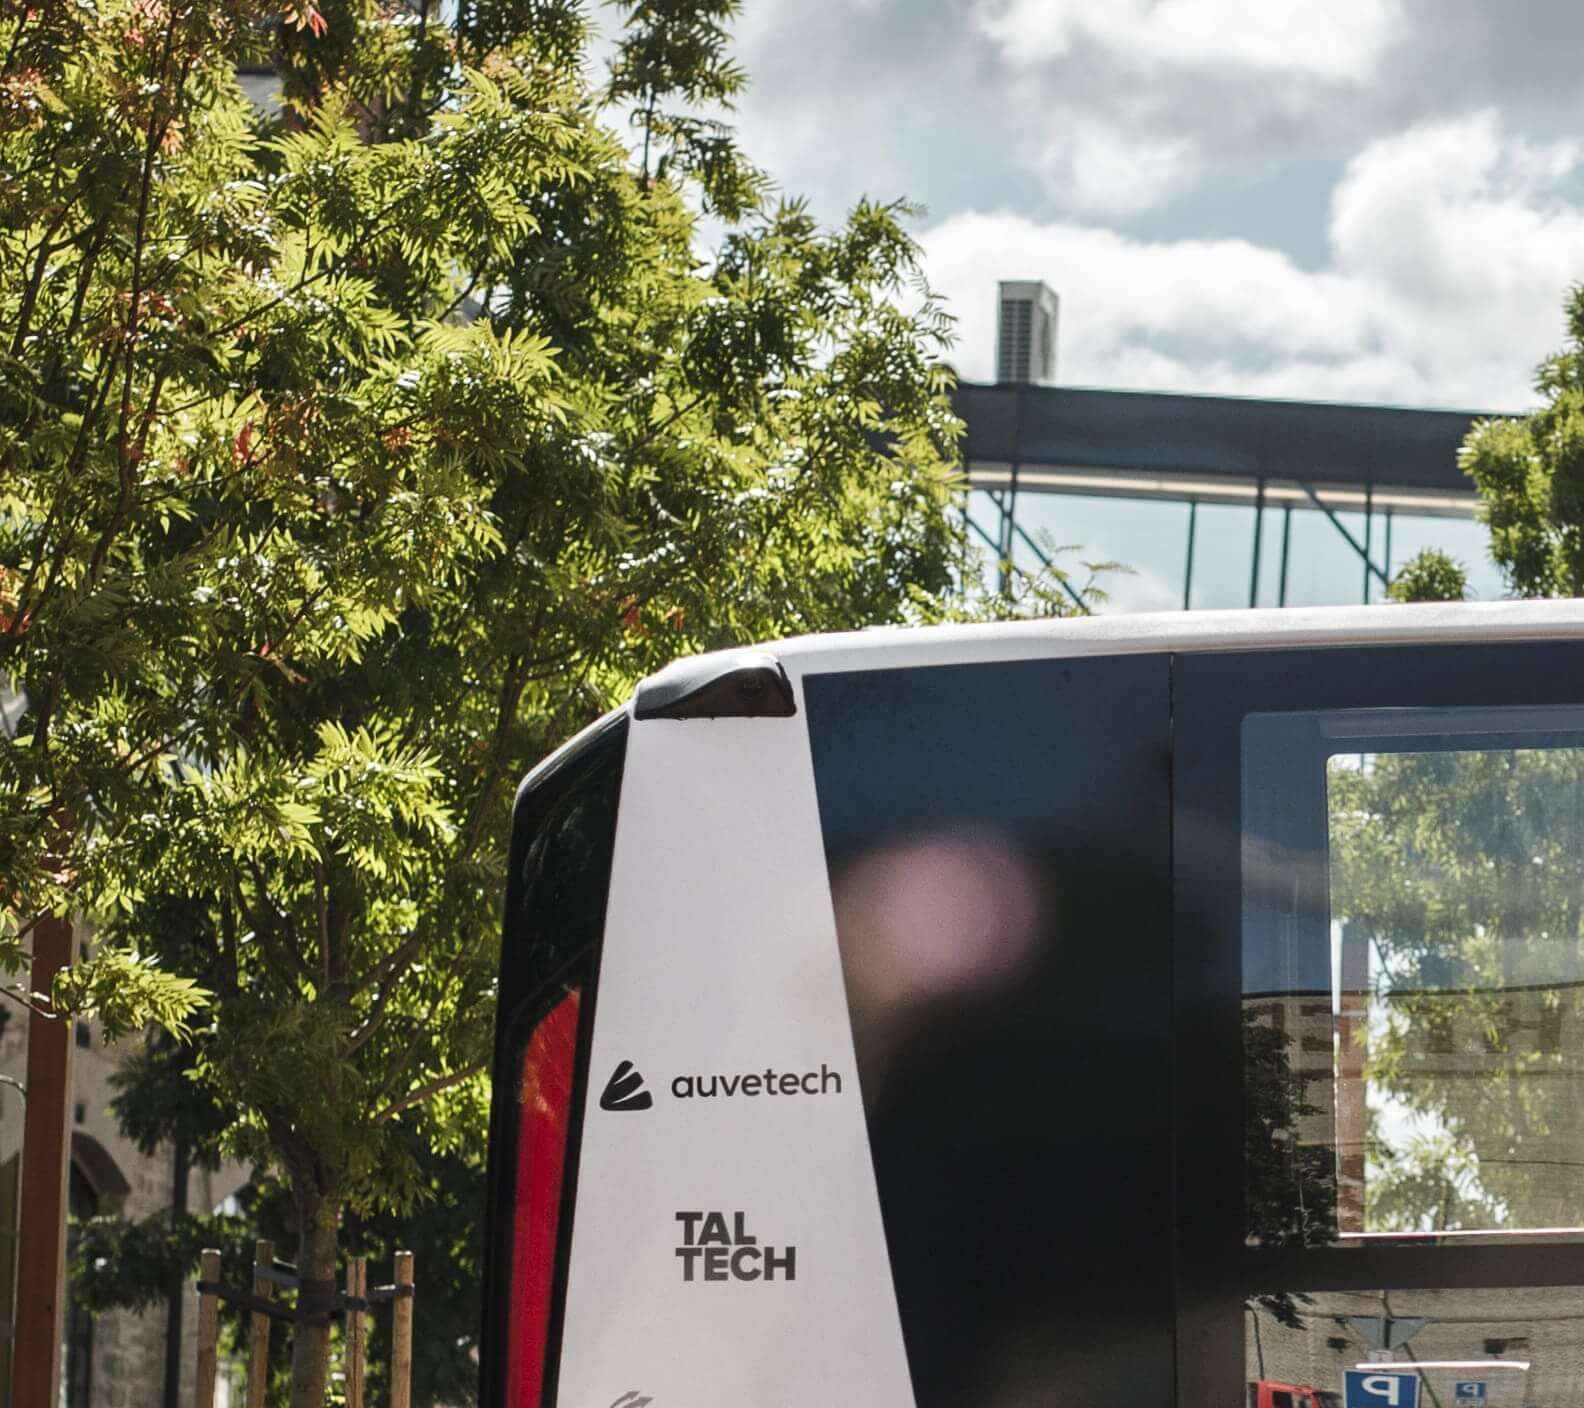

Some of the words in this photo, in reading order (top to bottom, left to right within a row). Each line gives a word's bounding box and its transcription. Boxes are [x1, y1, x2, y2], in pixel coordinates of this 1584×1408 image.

[671, 1063, 842, 1099] auvetech
[675, 1211, 756, 1246] TAL
[675, 1246, 797, 1282] TECH
